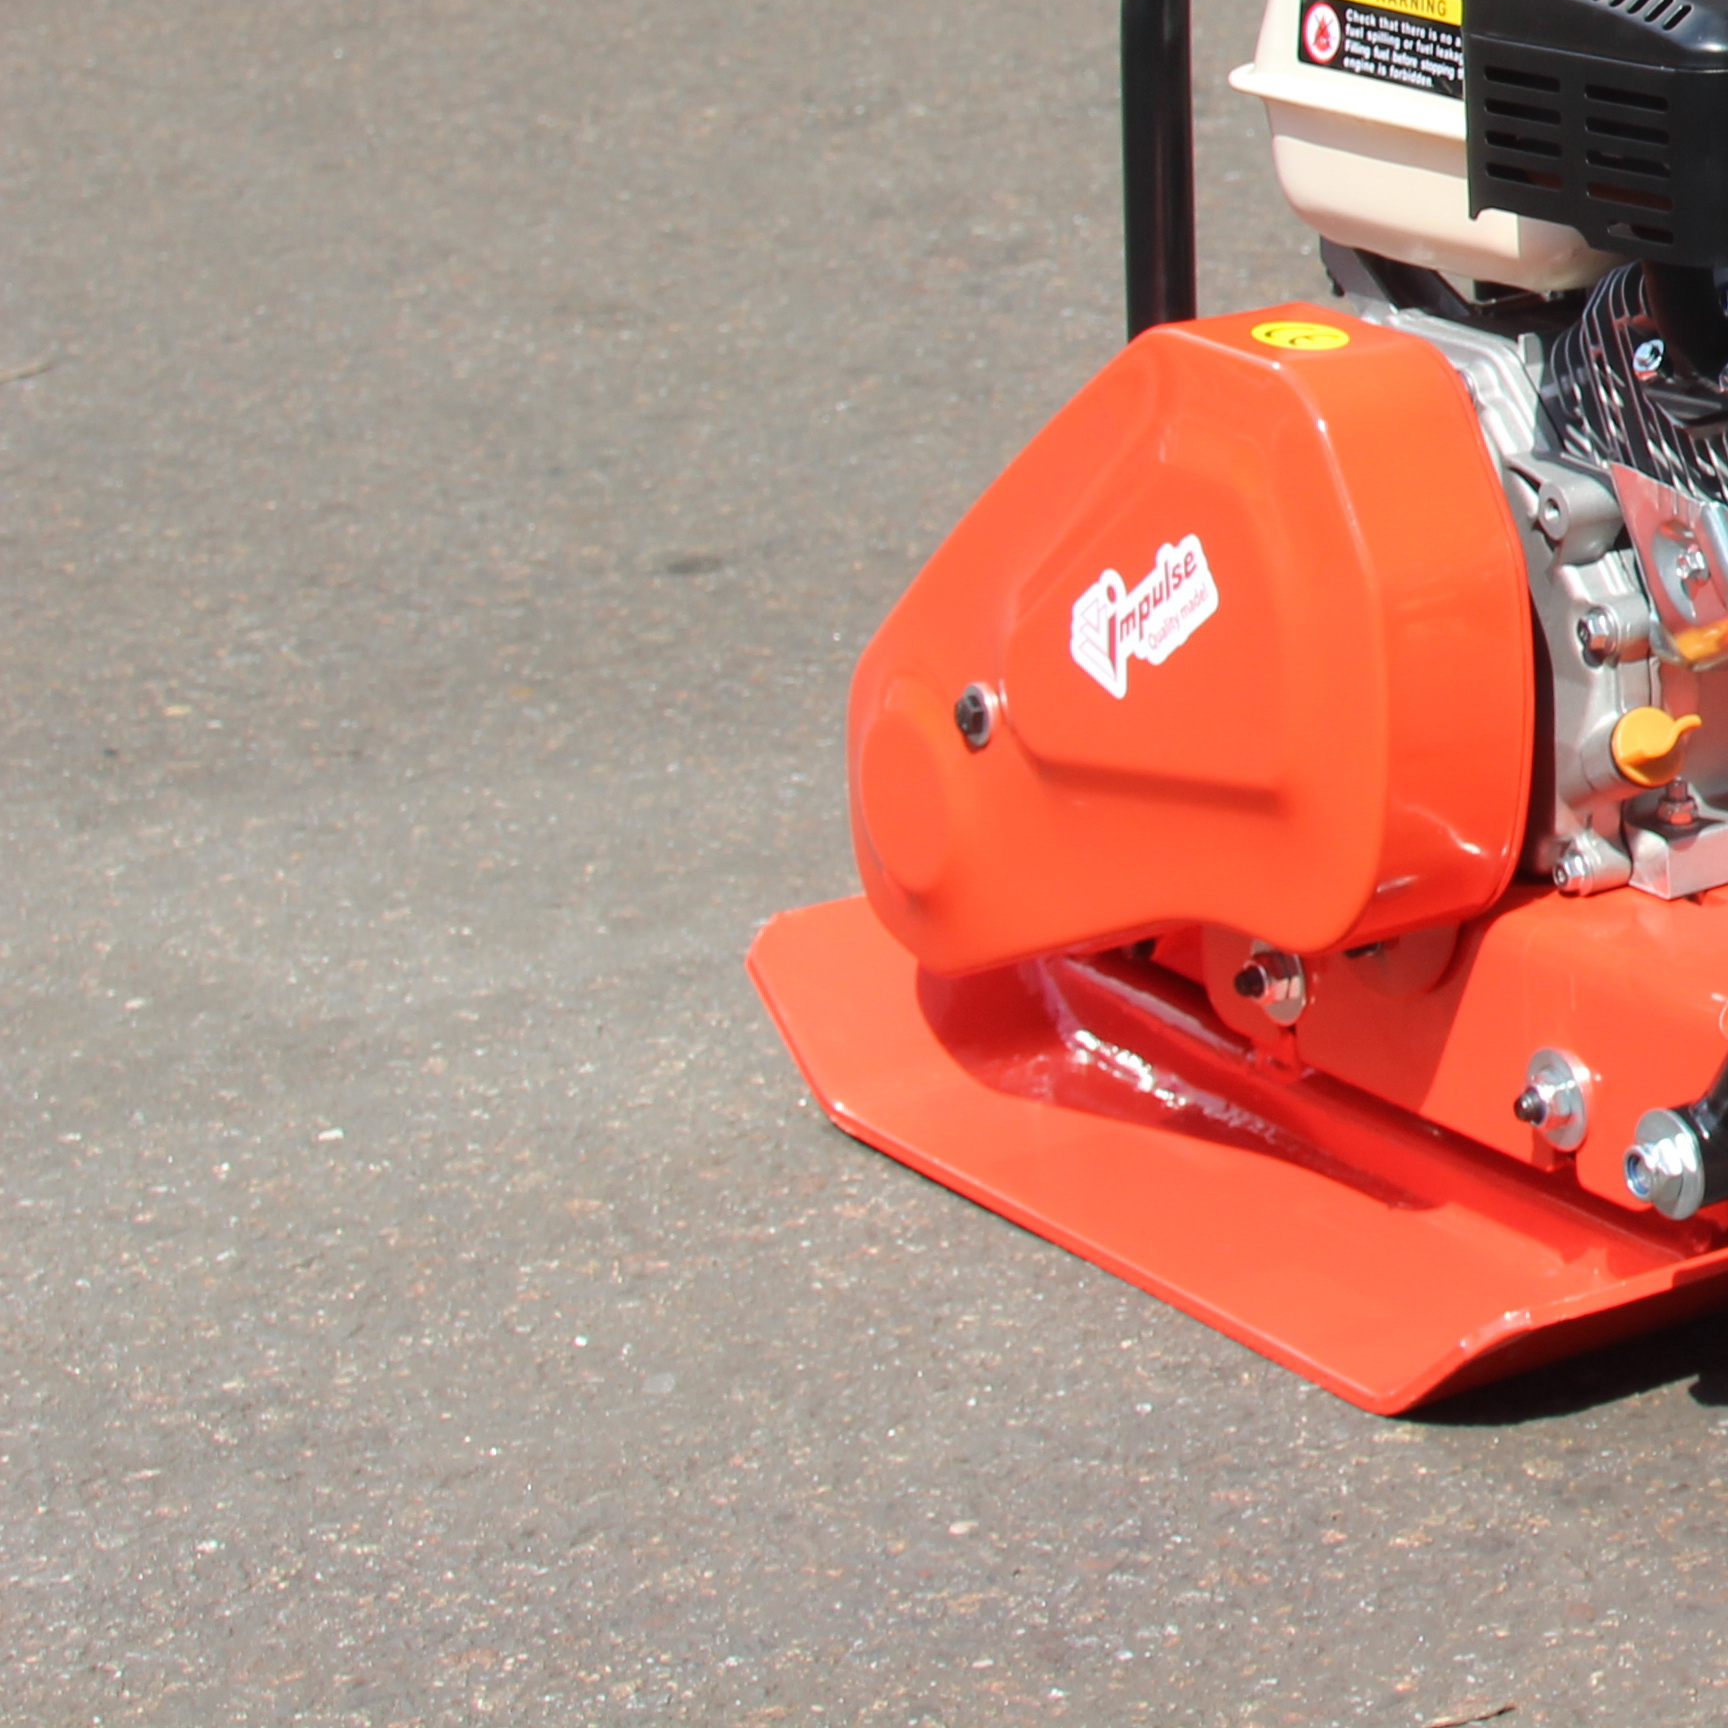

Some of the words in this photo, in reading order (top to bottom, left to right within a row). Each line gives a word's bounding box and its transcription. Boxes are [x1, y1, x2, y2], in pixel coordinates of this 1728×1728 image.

[1345, 7, 1377, 27] Check
[1379, 16, 1399, 32] that
[1401, 21, 1426, 39] there
[1428, 27, 1438, 42] is
[1439, 32, 1453, 45] no
[1345, 23, 1364, 39] fuel
[1366, 30, 1401, 50] spilling
[1403, 38, 1414, 50] or
[1416, 39, 1434, 56] fuel
[1343, 56, 1375, 73] engine
[1377, 62, 1387, 76] is
[1344, 38, 1371, 59] Filling
[1373, 45, 1390, 61] fuel
[1392, 50, 1418, 68] before
[1420, 58, 1456, 81] stopping
[1147, 613, 1181, 650] Quality
[1179, 582, 1210, 620] made!
